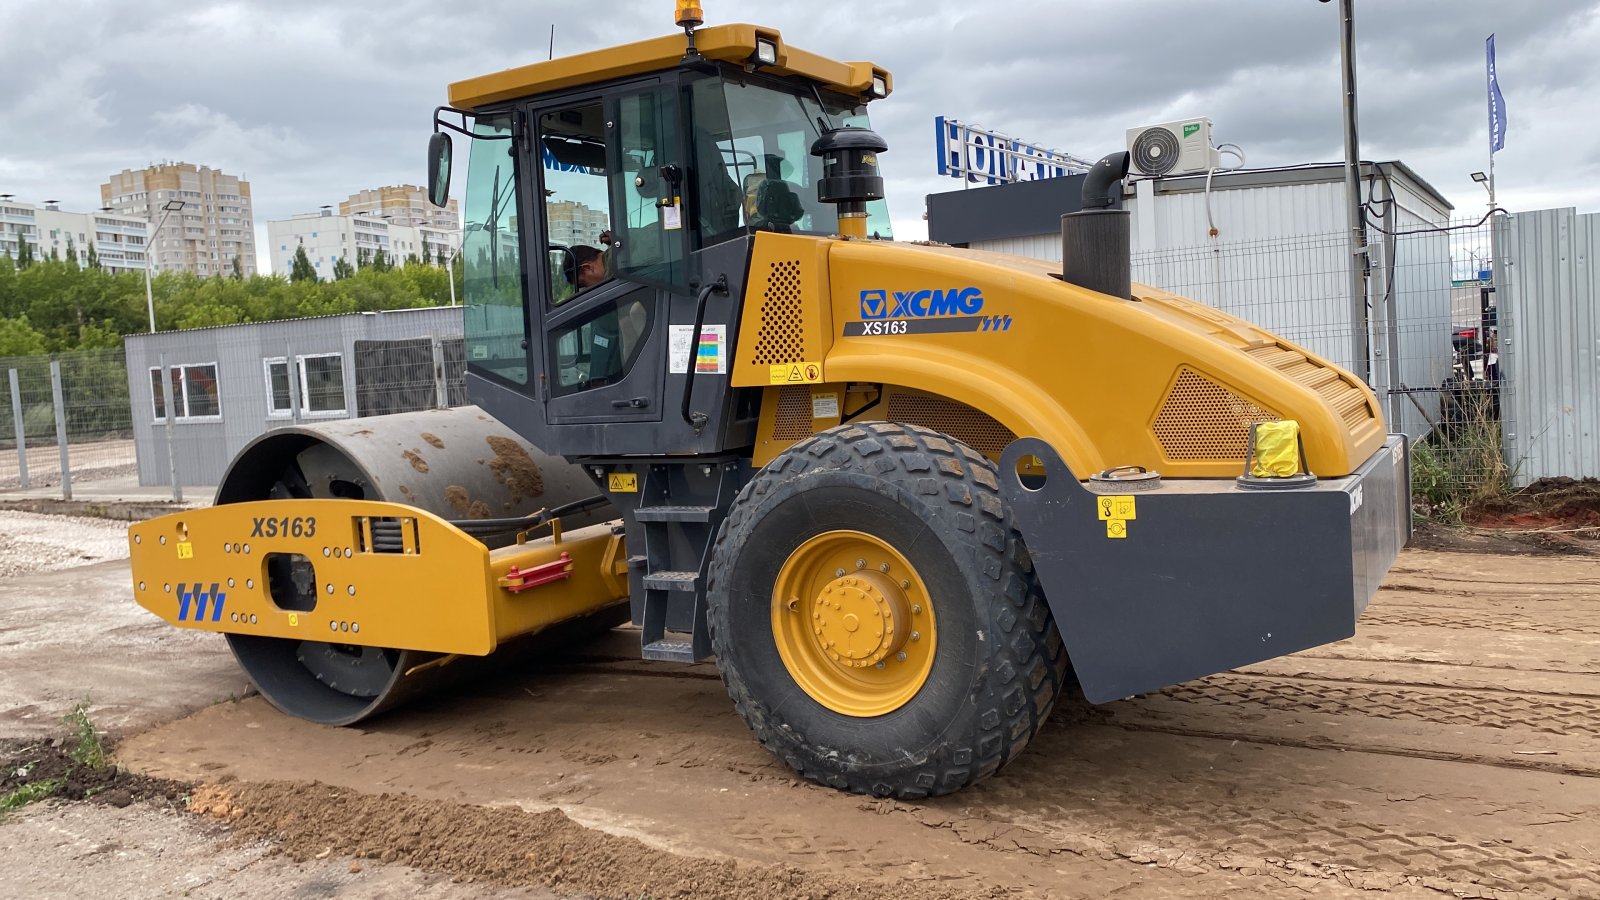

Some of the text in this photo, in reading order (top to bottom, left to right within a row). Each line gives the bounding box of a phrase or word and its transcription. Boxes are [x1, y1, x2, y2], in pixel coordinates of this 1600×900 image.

[888, 287, 984, 318] XCMG
[862, 320, 907, 336] XS163
[250, 516, 316, 538] XS163
